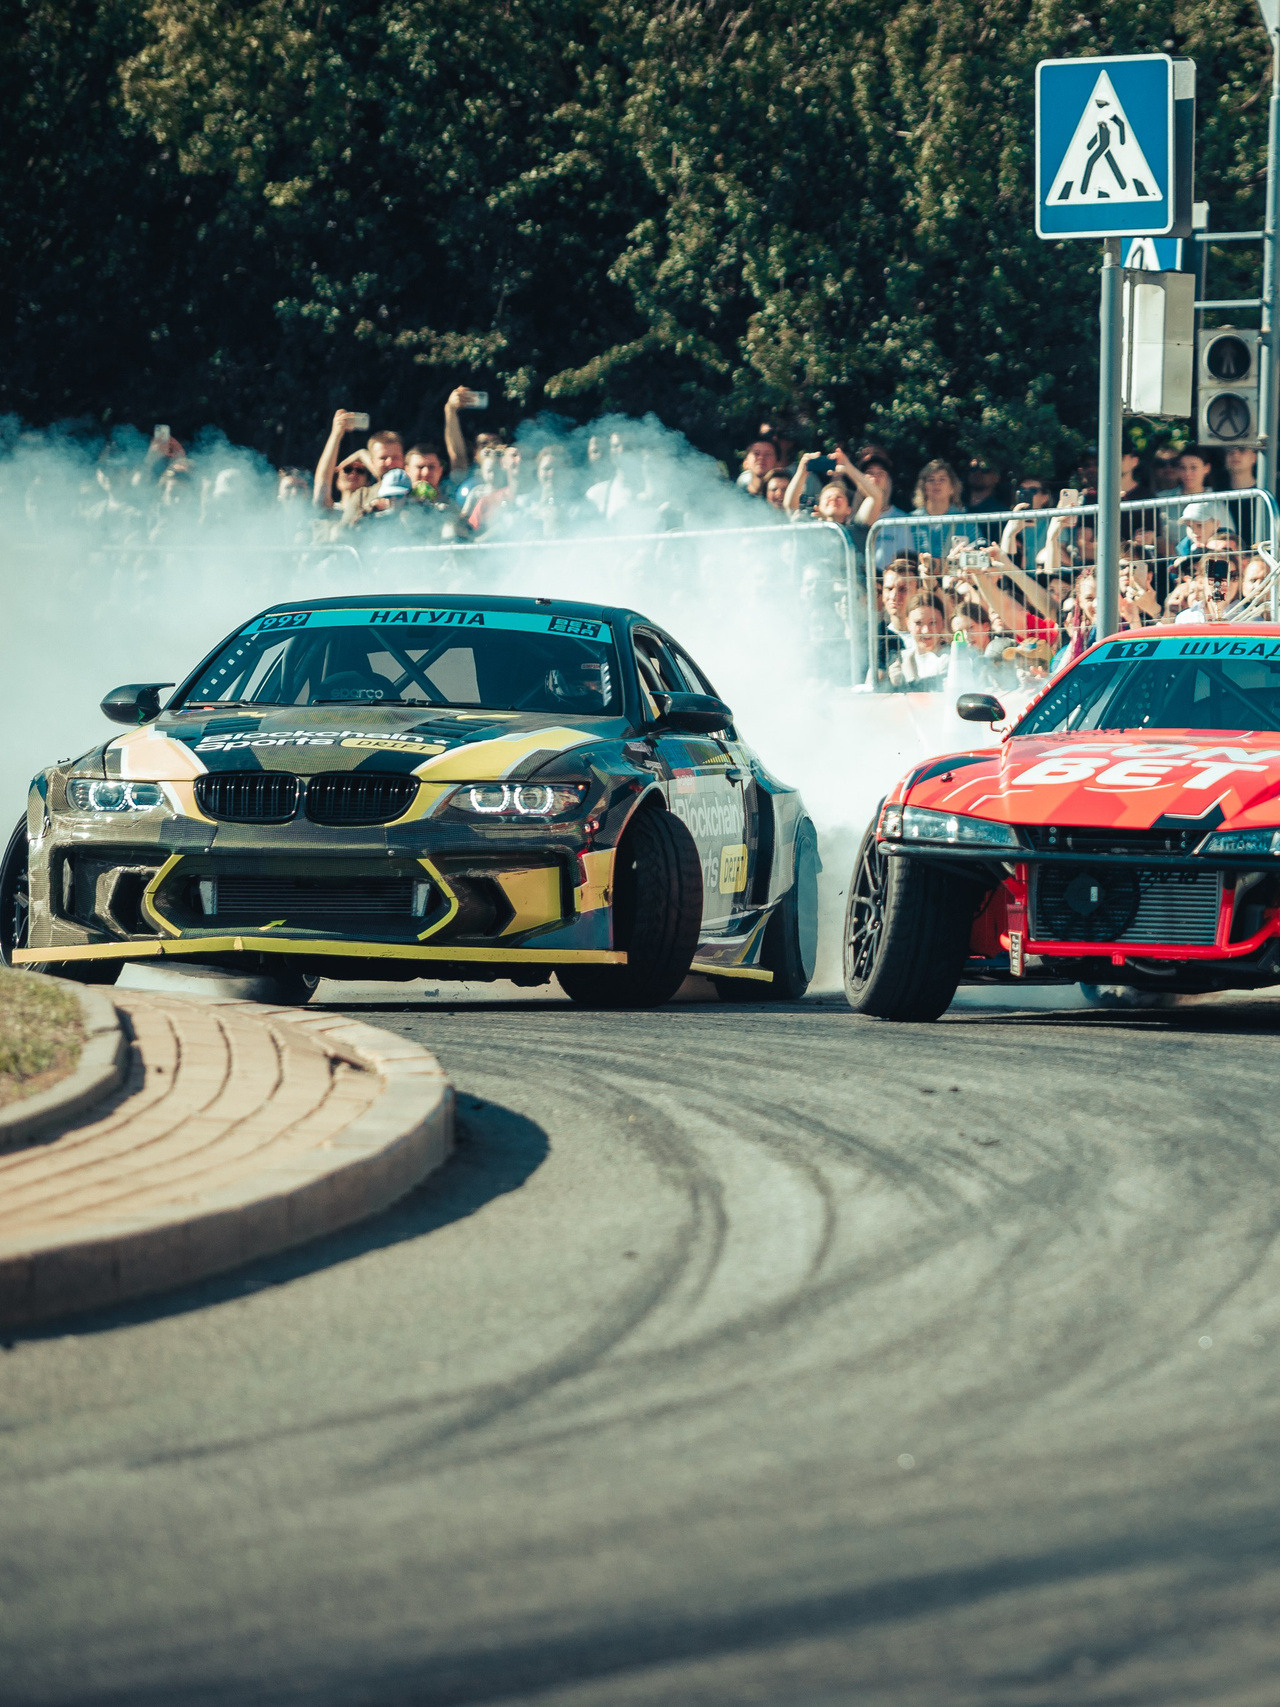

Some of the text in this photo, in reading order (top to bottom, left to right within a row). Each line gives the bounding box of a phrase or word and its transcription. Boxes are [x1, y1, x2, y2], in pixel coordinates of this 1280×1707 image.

[262, 614, 307, 631] 999
[369, 611, 486, 626] НАГУЛА
[553, 618, 596, 629] BET
[1120, 643, 1148, 657] 19
[200, 730, 424, 743] Blockchain
[194, 737, 433, 751] Sports DRIFT
[1011, 757, 1269, 790] BET
